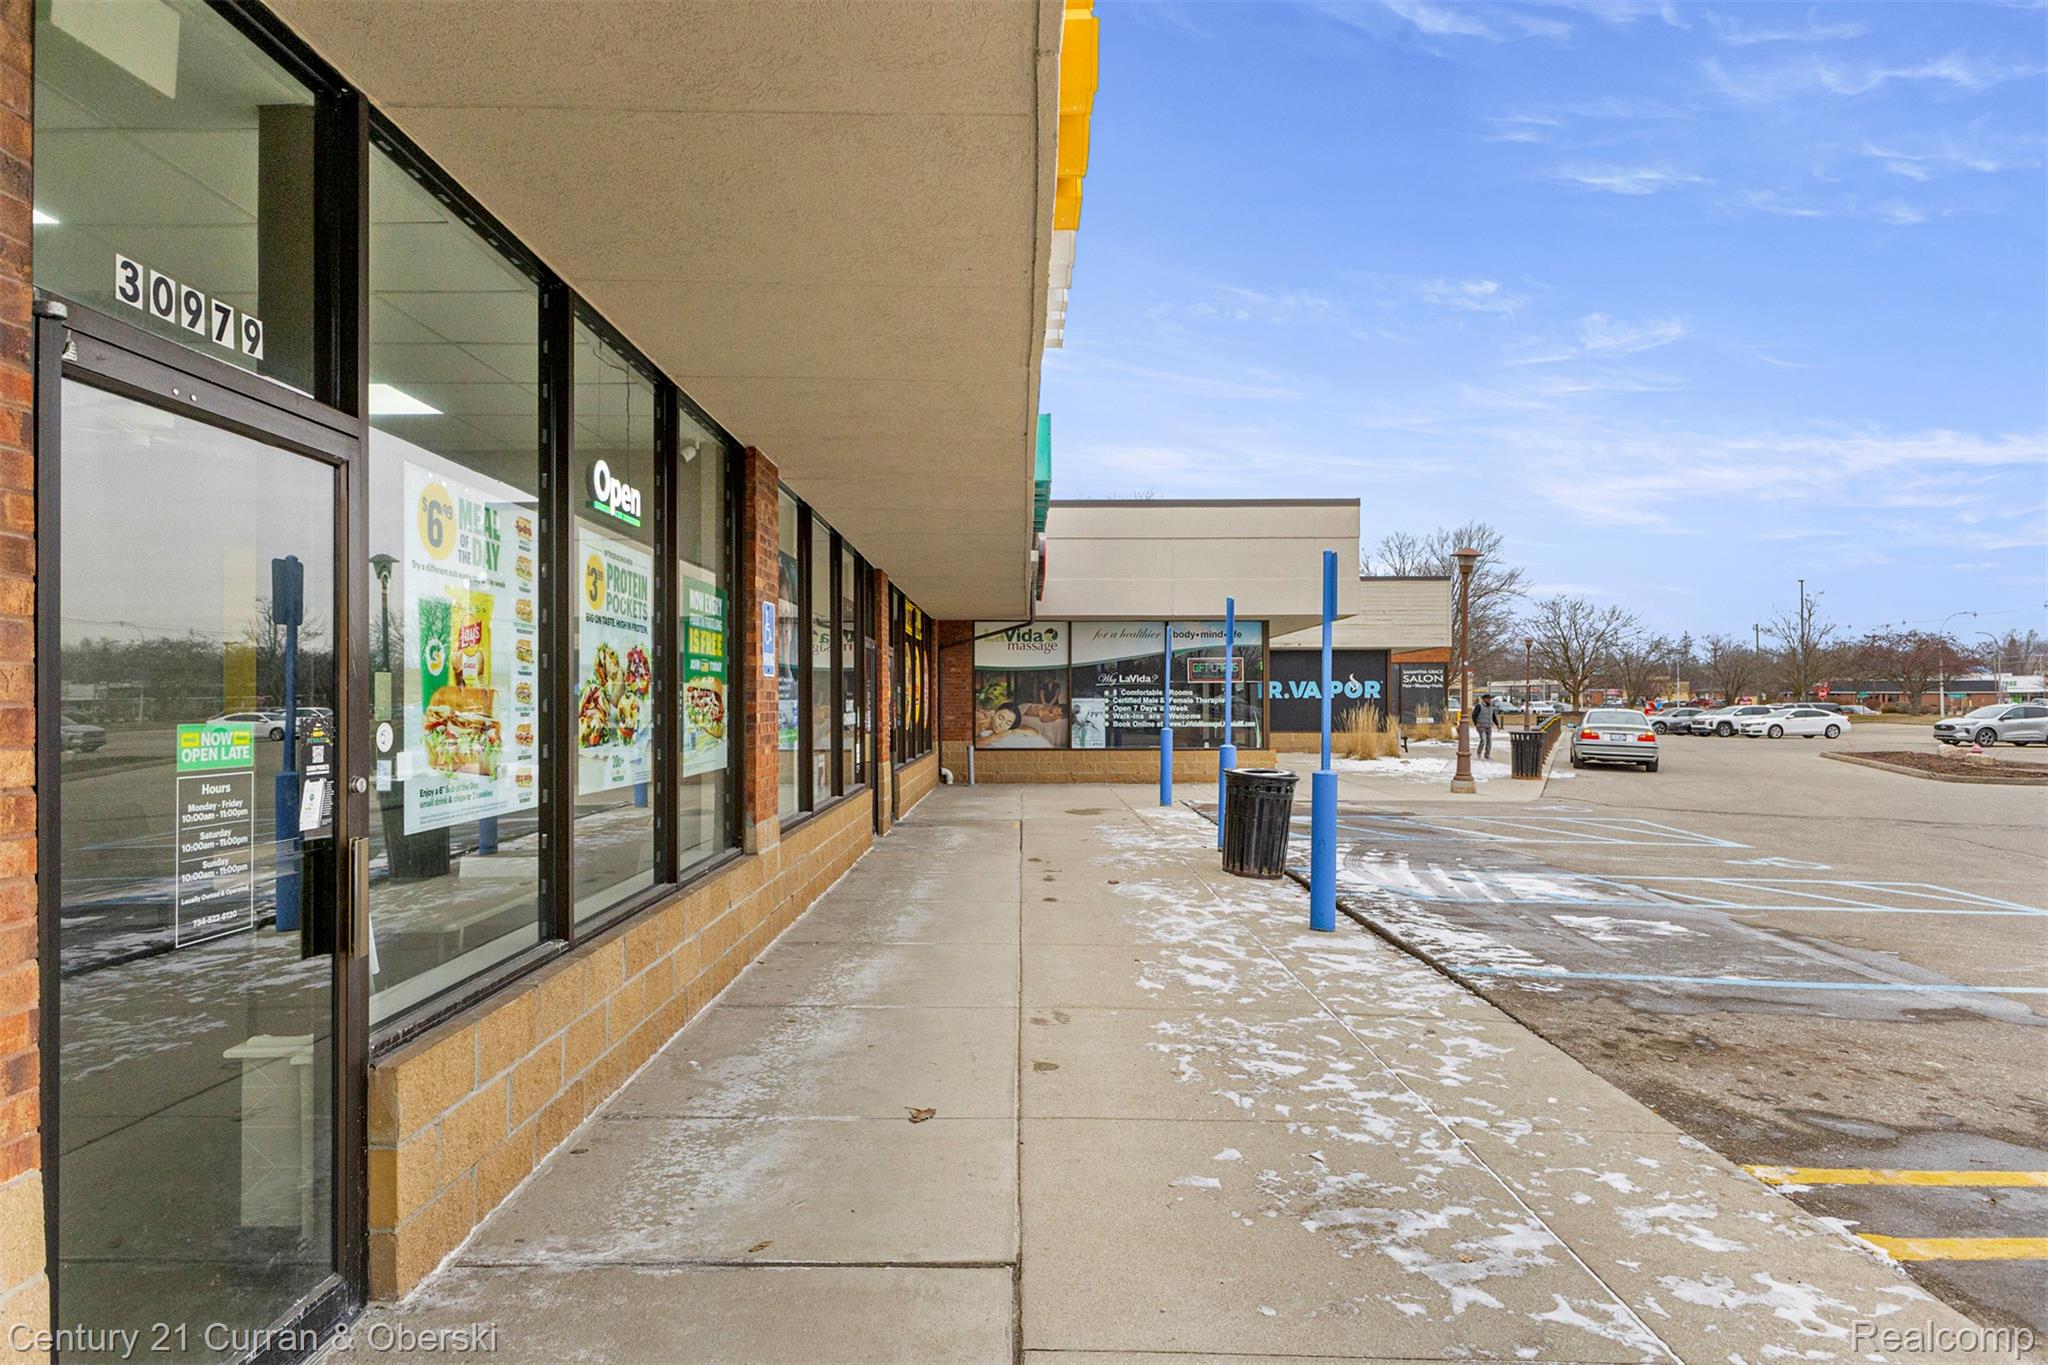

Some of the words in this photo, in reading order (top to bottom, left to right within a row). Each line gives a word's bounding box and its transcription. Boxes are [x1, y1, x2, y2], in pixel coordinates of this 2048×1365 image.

[118, 259, 262, 355] 30979
[593, 459, 641, 517] Open
[460, 533, 469, 549] OF
[458, 549, 472, 565] THE
[472, 537, 500, 571] DAY
[606, 563, 648, 601] PROTEIN
[606, 592, 648, 621] POCKETS
[1119, 627, 1161, 639] healthier
[1007, 642, 1058, 654] massage
[1097, 672, 1118, 686] Why
[1403, 674, 1443, 683] SALON
[1257, 680, 1382, 699] R.VAPOR
[1112, 705, 1132, 713] Open
[201, 732, 233, 746] NOW
[181, 747, 218, 763] OPEN
[221, 745, 250, 760] LATE
[201, 783, 231, 795] Hours
[419, 788, 434, 798] Enjoy
[187, 801, 217, 813] Monday
[222, 799, 243, 809] Friday
[182, 813, 215, 823] 10:00am
[200, 828, 232, 840] Saturday
[181, 842, 215, 853] 10:00am
[202, 857, 229, 869] Sunday
[181, 870, 215, 883] 10:00am
